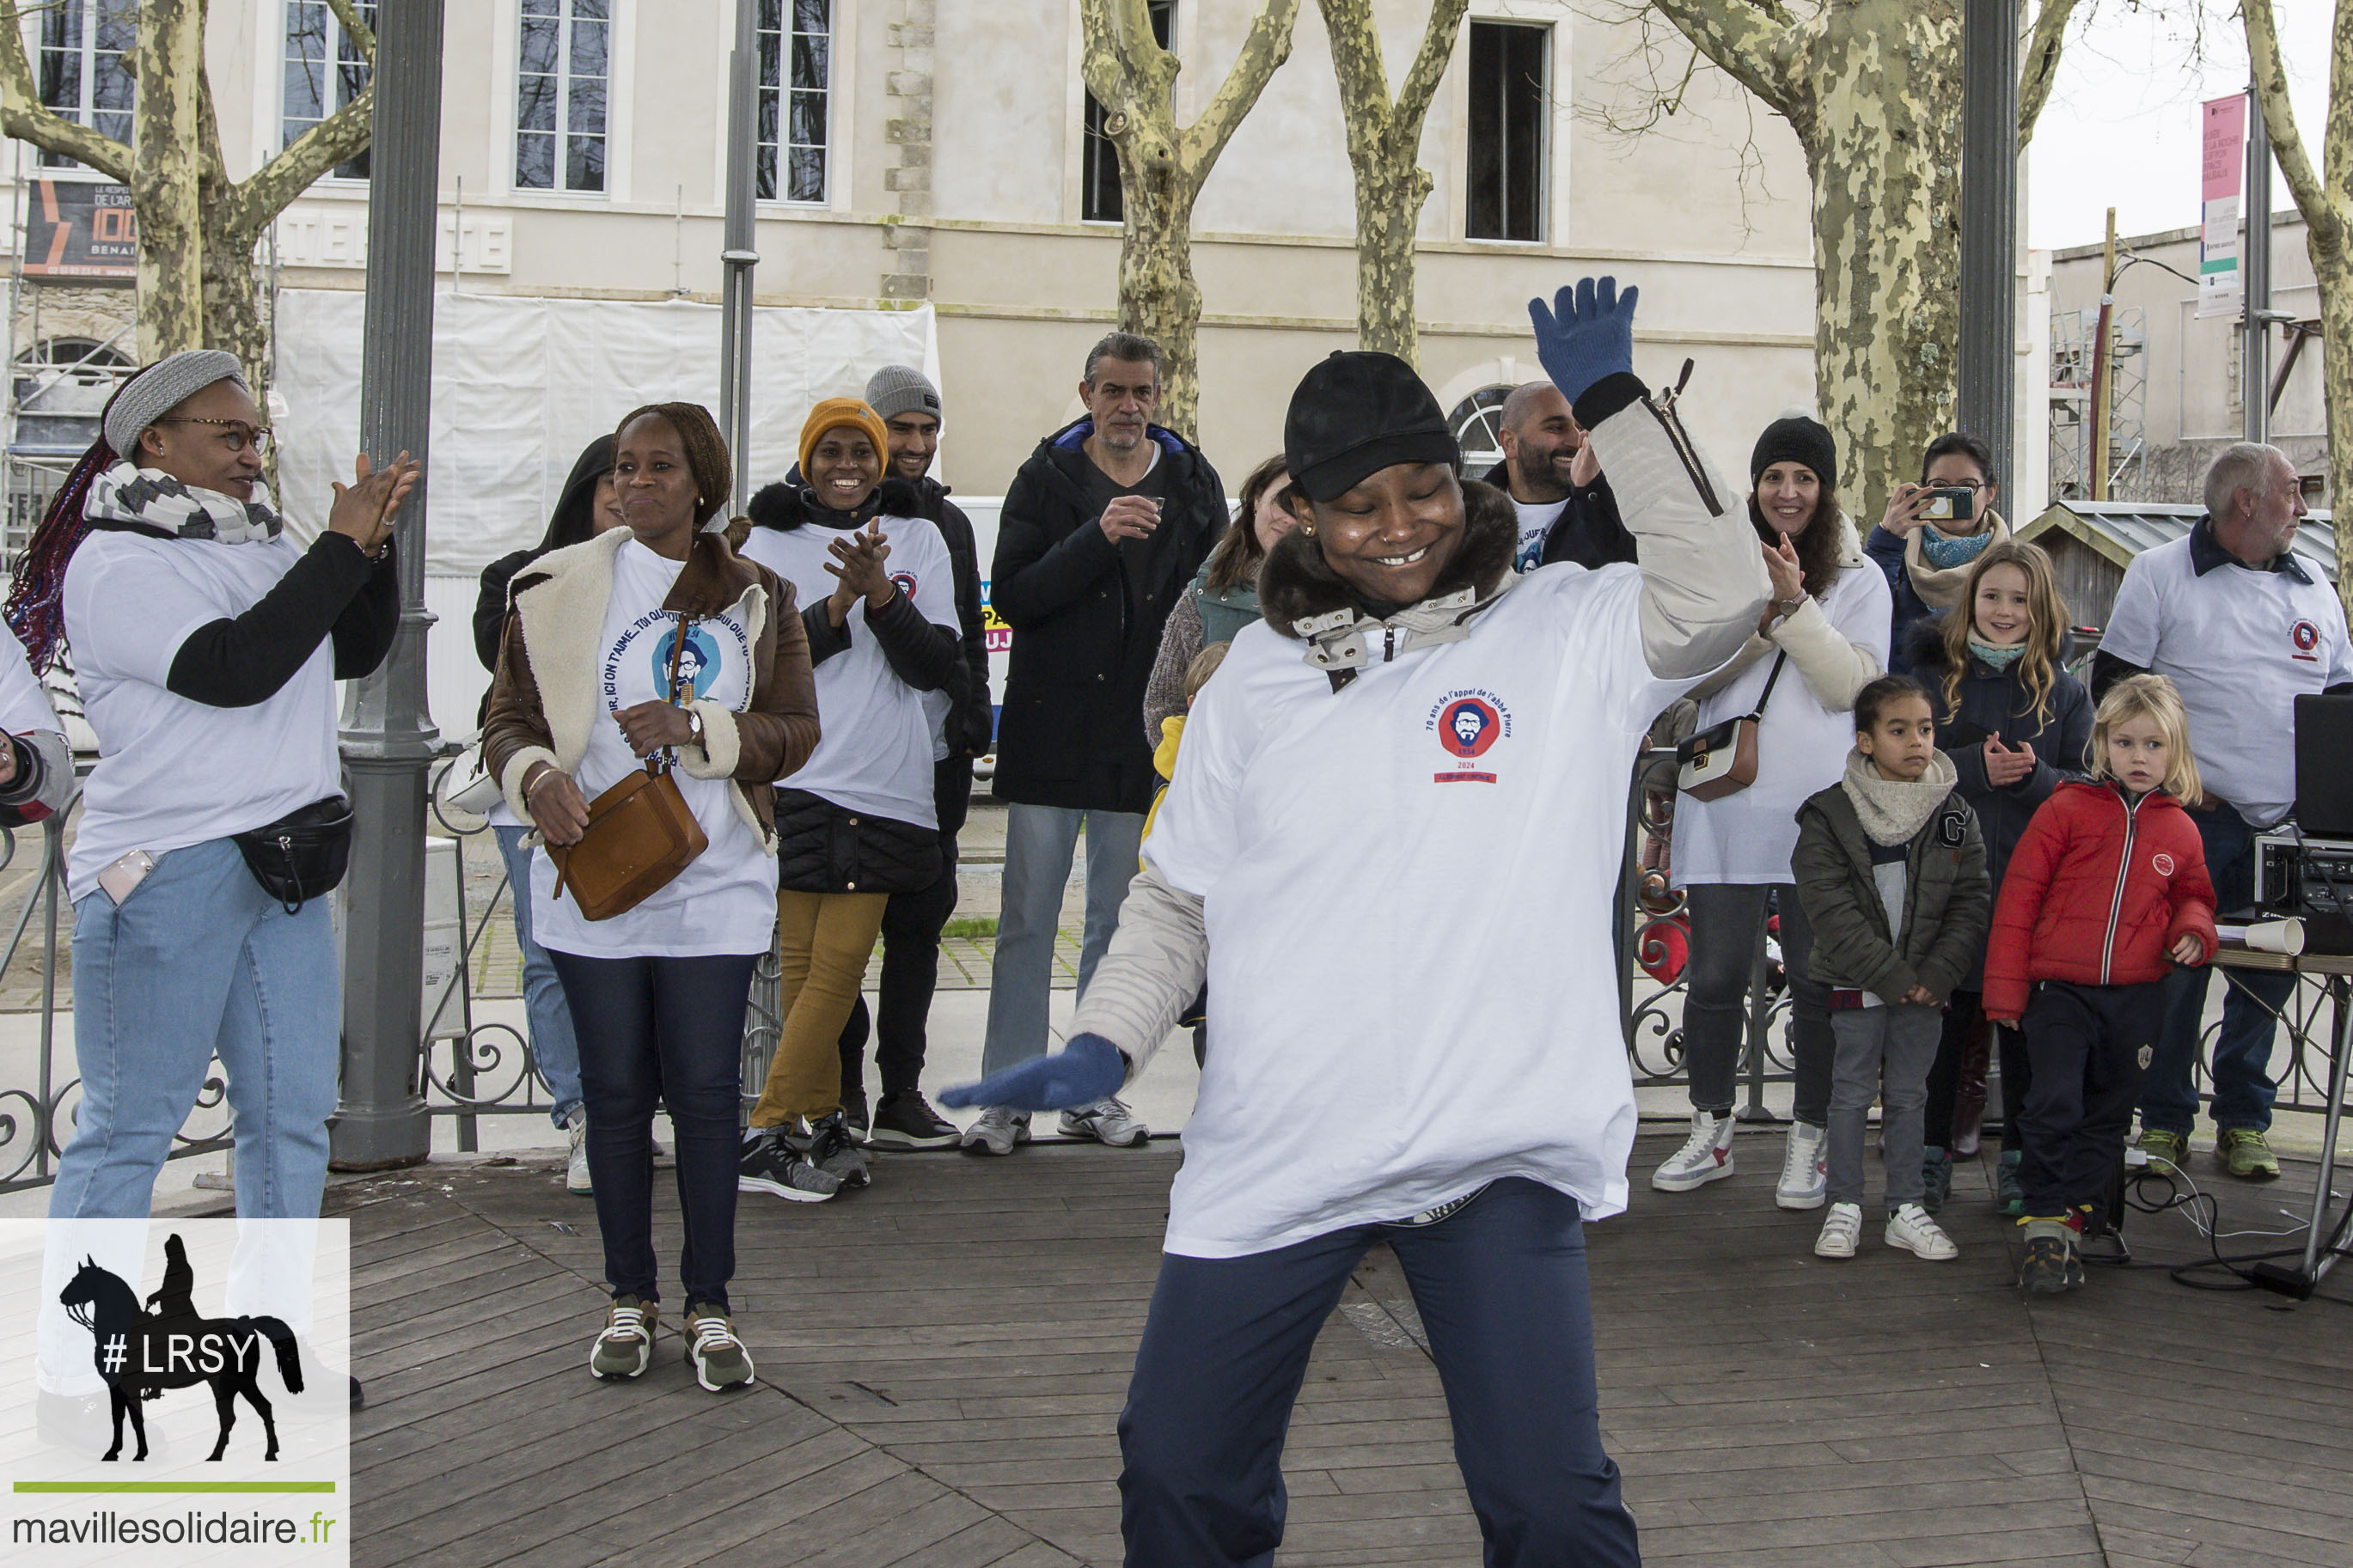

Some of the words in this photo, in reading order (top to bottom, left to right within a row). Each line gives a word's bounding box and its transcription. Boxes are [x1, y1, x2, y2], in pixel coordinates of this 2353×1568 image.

[95, 194, 109, 206] DE
[111, 194, 131, 206] L'AR
[91, 245, 135, 254] BENAI
[633, 617, 651, 630] TOI
[729, 623, 747, 644] QUE
[604, 664, 617, 680] ON
[604, 682, 616, 695] ICI
[1426, 720, 1434, 731] 70
[1430, 705, 1440, 718] ans
[1439, 696, 1448, 705] de
[1448, 688, 1476, 699] l'appel
[1488, 692, 1507, 713] l'abbé
[1503, 713, 1512, 738] Pierre
[1939, 810, 1966, 849] C
